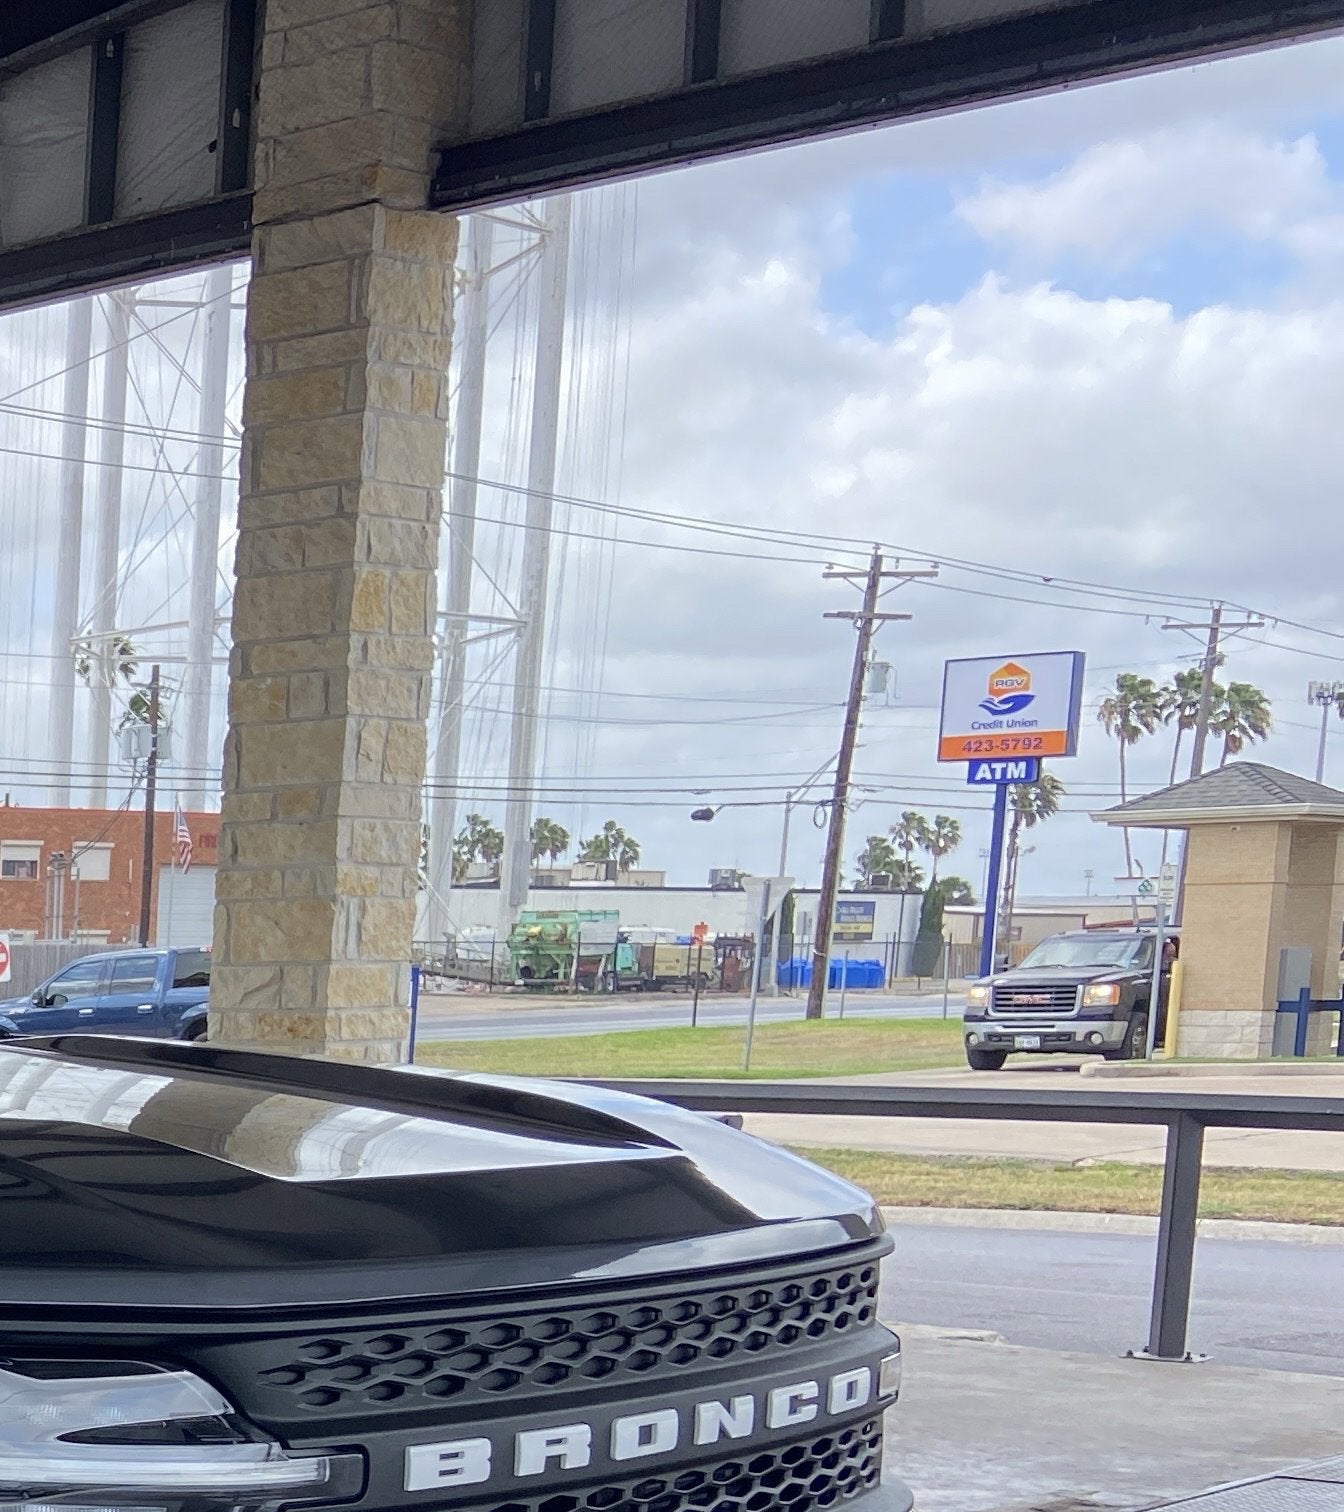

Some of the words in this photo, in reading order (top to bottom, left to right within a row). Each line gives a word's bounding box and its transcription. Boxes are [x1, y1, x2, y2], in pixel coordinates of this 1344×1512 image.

[995, 678, 1025, 688] RGV
[972, 720, 1003, 730] Credit
[1006, 718, 1038, 729] Union
[962, 737, 1043, 752] 423-5792
[974, 760, 1027, 780] ATM
[403, 1366, 872, 1492] BRONCO
